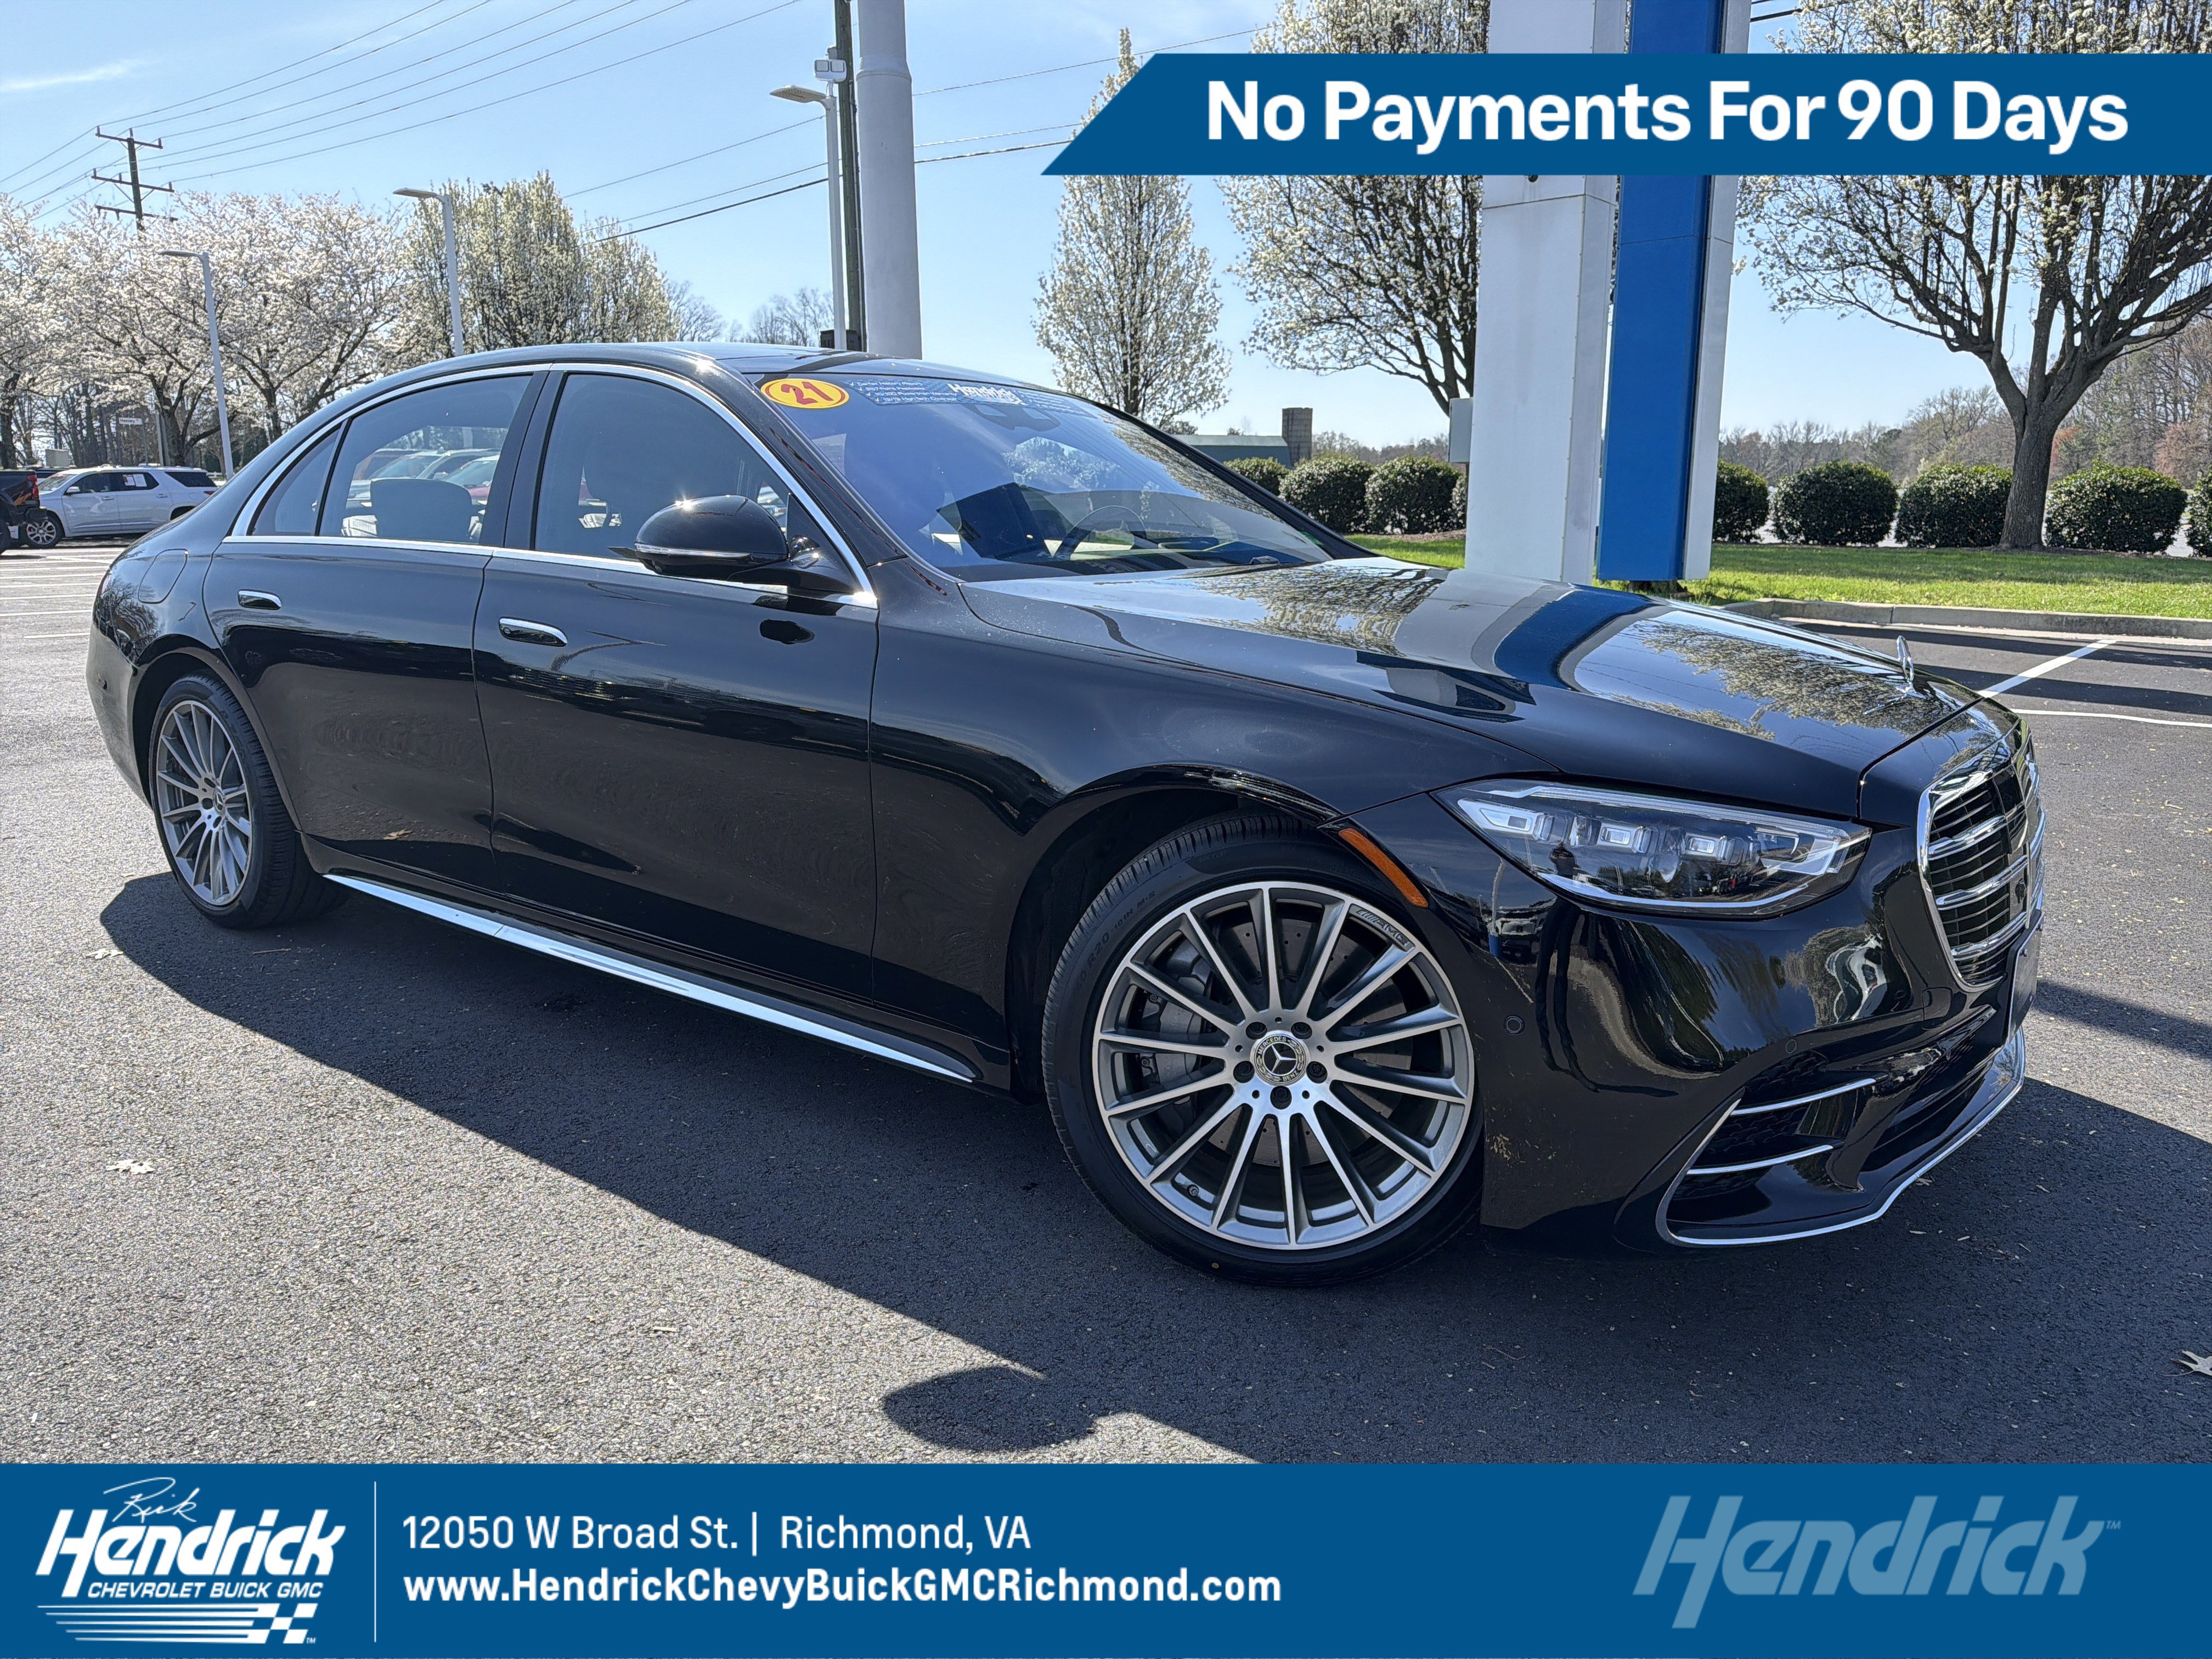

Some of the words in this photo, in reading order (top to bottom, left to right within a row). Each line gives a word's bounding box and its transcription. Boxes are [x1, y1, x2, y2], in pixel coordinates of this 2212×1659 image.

[781, 383, 833, 404] 21
[1257, 1036, 1287, 1055] MERCEDES
[1283, 1070, 1299, 1081] BENZ
